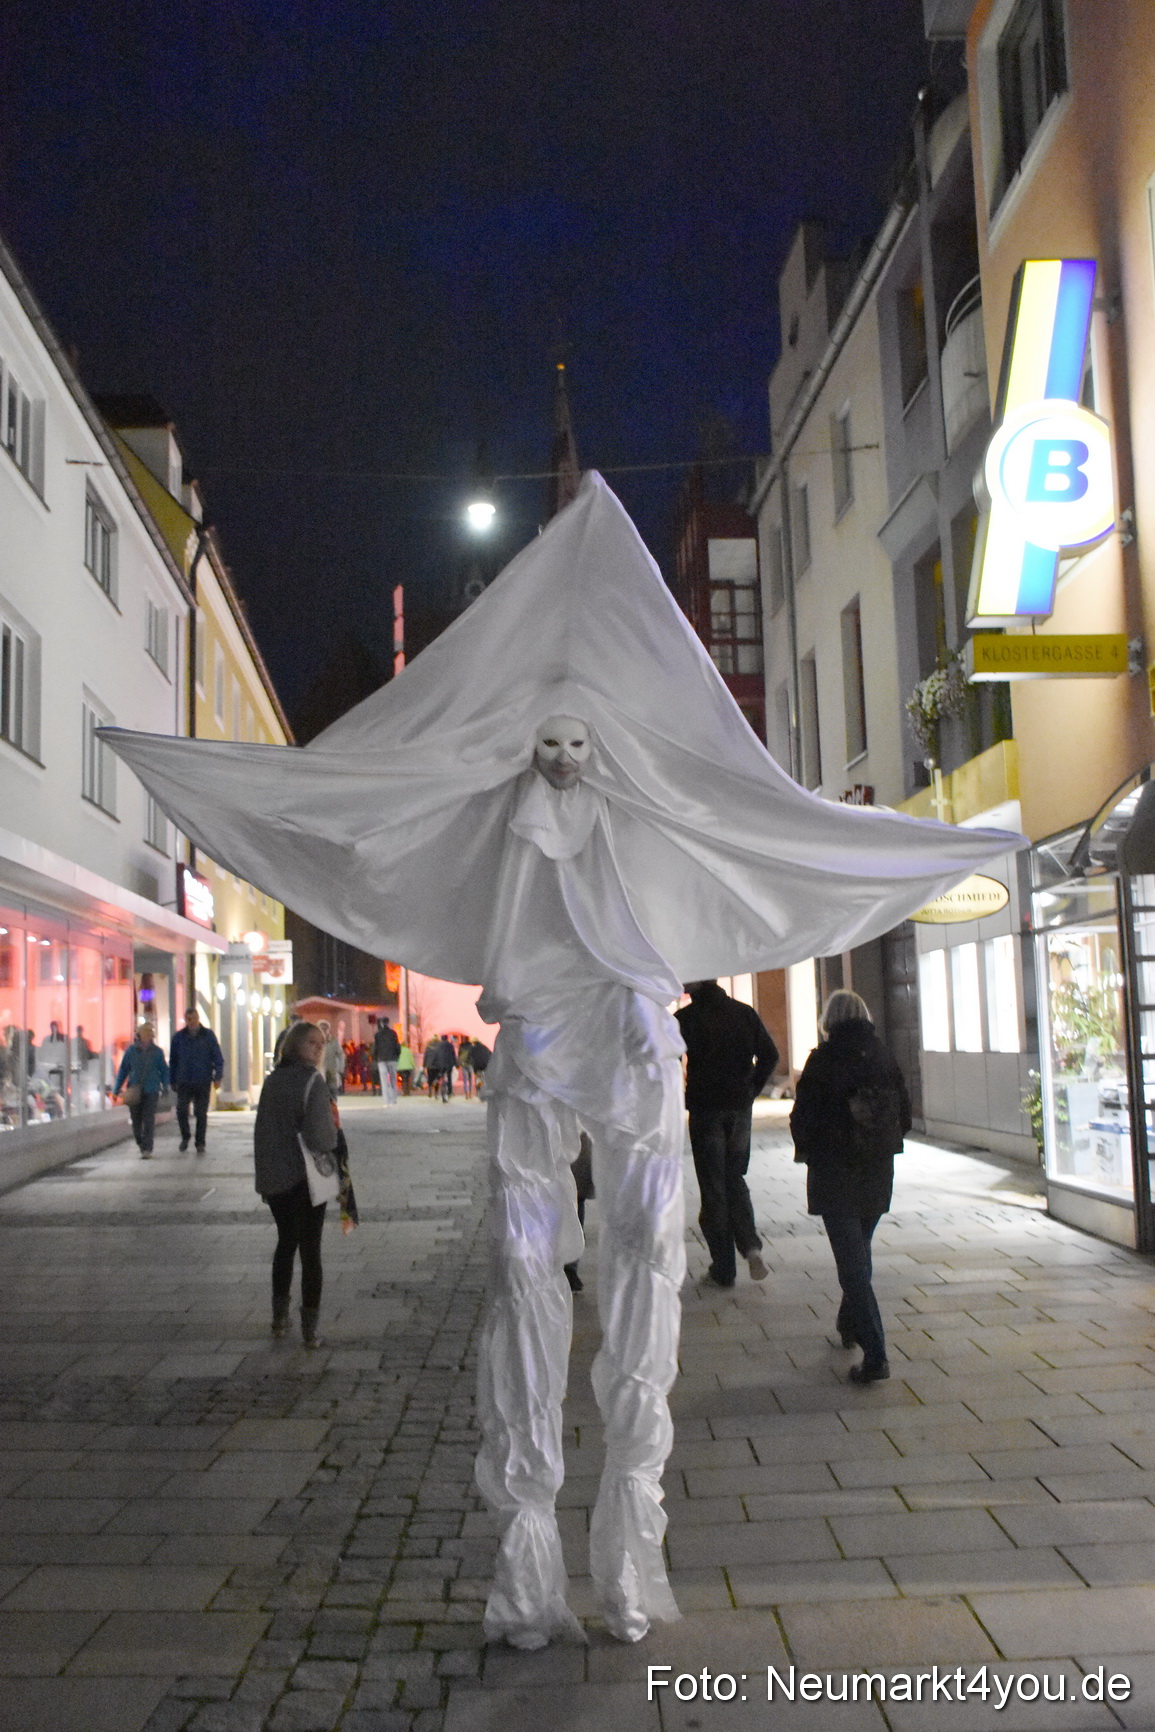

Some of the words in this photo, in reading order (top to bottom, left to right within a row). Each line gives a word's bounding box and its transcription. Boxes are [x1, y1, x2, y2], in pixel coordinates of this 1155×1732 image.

[1026, 440, 1089, 502] B
[982, 644, 1104, 662] KLOSTERGASSE
[1110, 643, 1121, 659] 4
